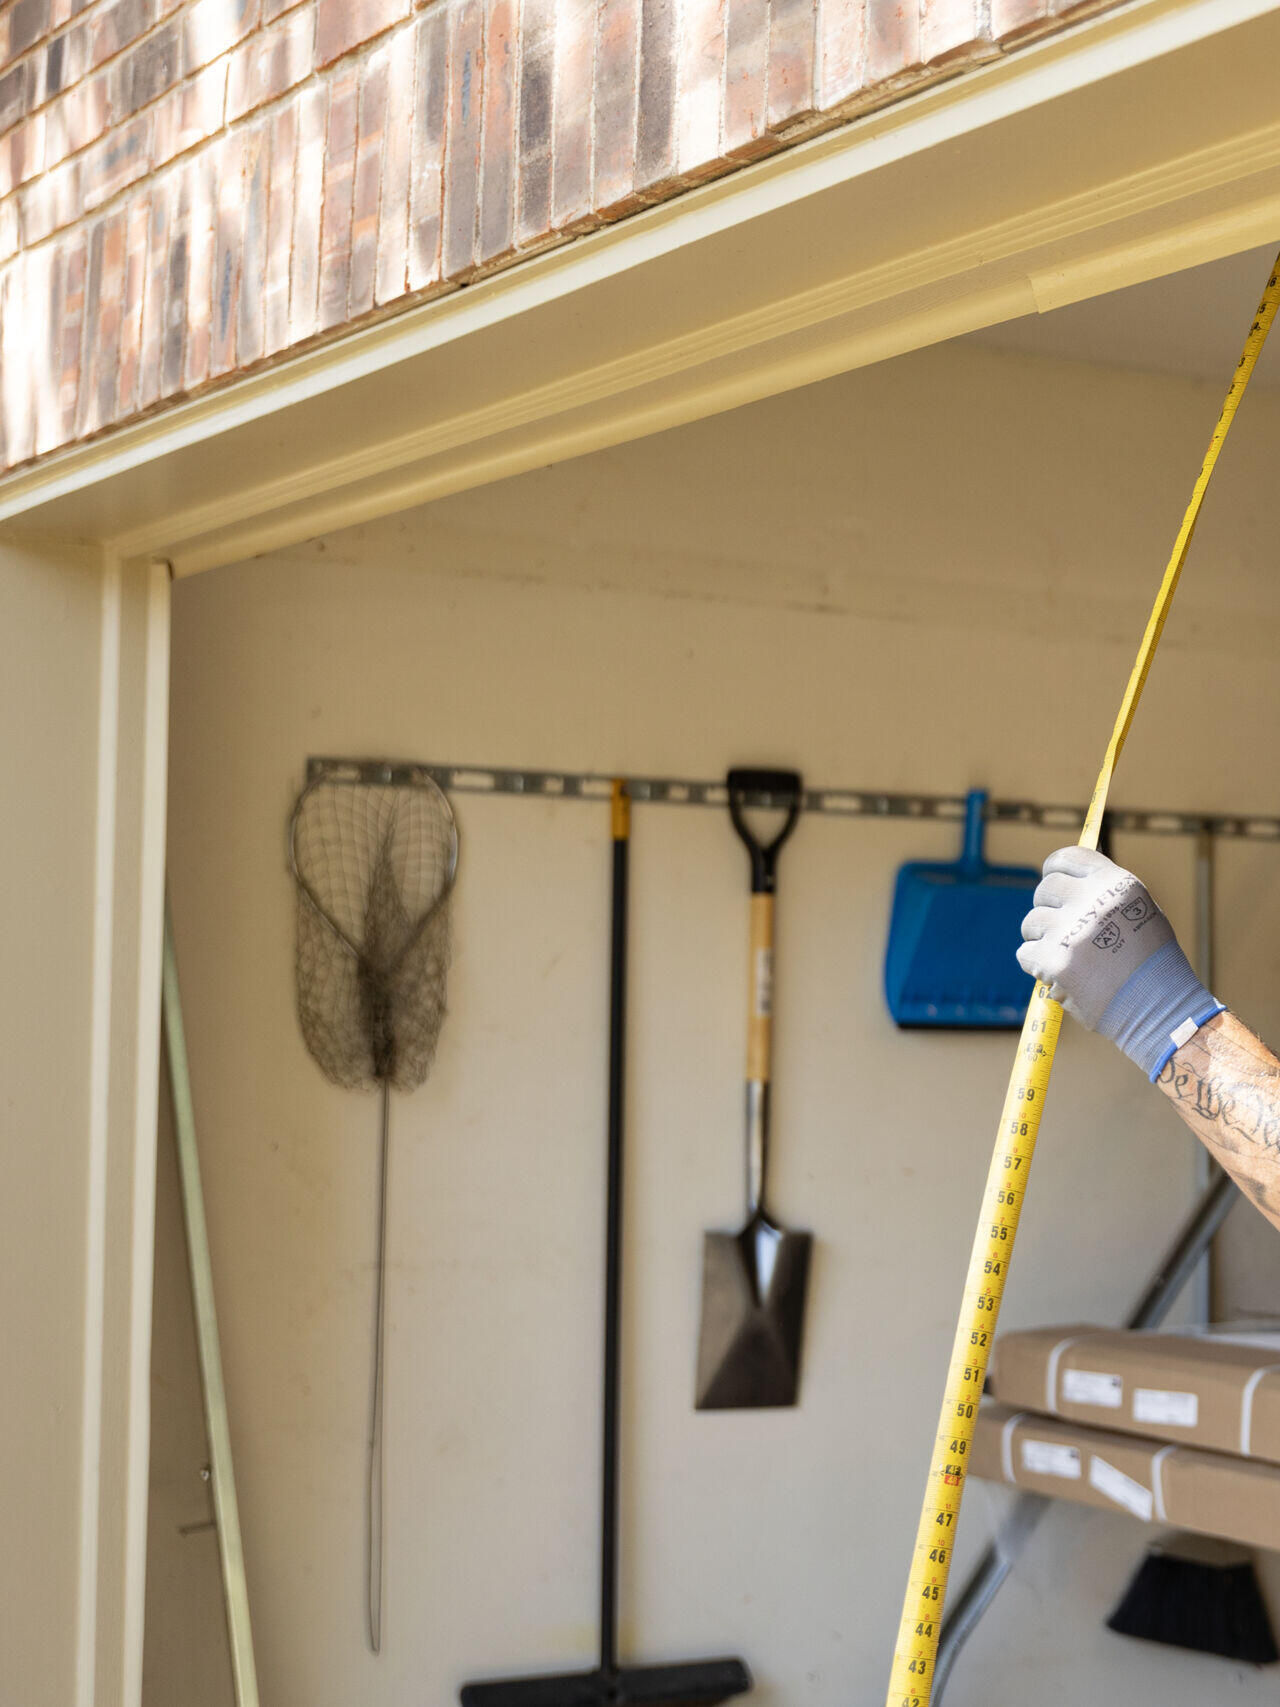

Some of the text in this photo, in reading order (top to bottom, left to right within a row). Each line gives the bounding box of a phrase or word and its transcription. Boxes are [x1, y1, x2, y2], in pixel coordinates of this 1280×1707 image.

[1132, 907, 1142, 917] 3
[1112, 938, 1126, 954] CUT
[1031, 1020, 1047, 1033] 61
[1017, 1088, 1036, 1102] 59
[1011, 1121, 1028, 1136] 58
[1004, 1156, 1023, 1171] 57
[997, 1191, 1016, 1206] 56
[991, 1225, 1009, 1241] 55
[984, 1261, 1001, 1276] 54
[977, 1296, 994, 1312] 53
[970, 1331, 988, 1347] 52
[963, 1367, 980, 1383] 51
[956, 1403, 974, 1419] 50
[949, 1439, 967, 1455] 49
[936, 1511, 953, 1527] 47
[929, 1549, 947, 1564] 46
[922, 1585, 940, 1601] 45
[915, 1622, 933, 1637] 44
[908, 1660, 927, 1675] 43
